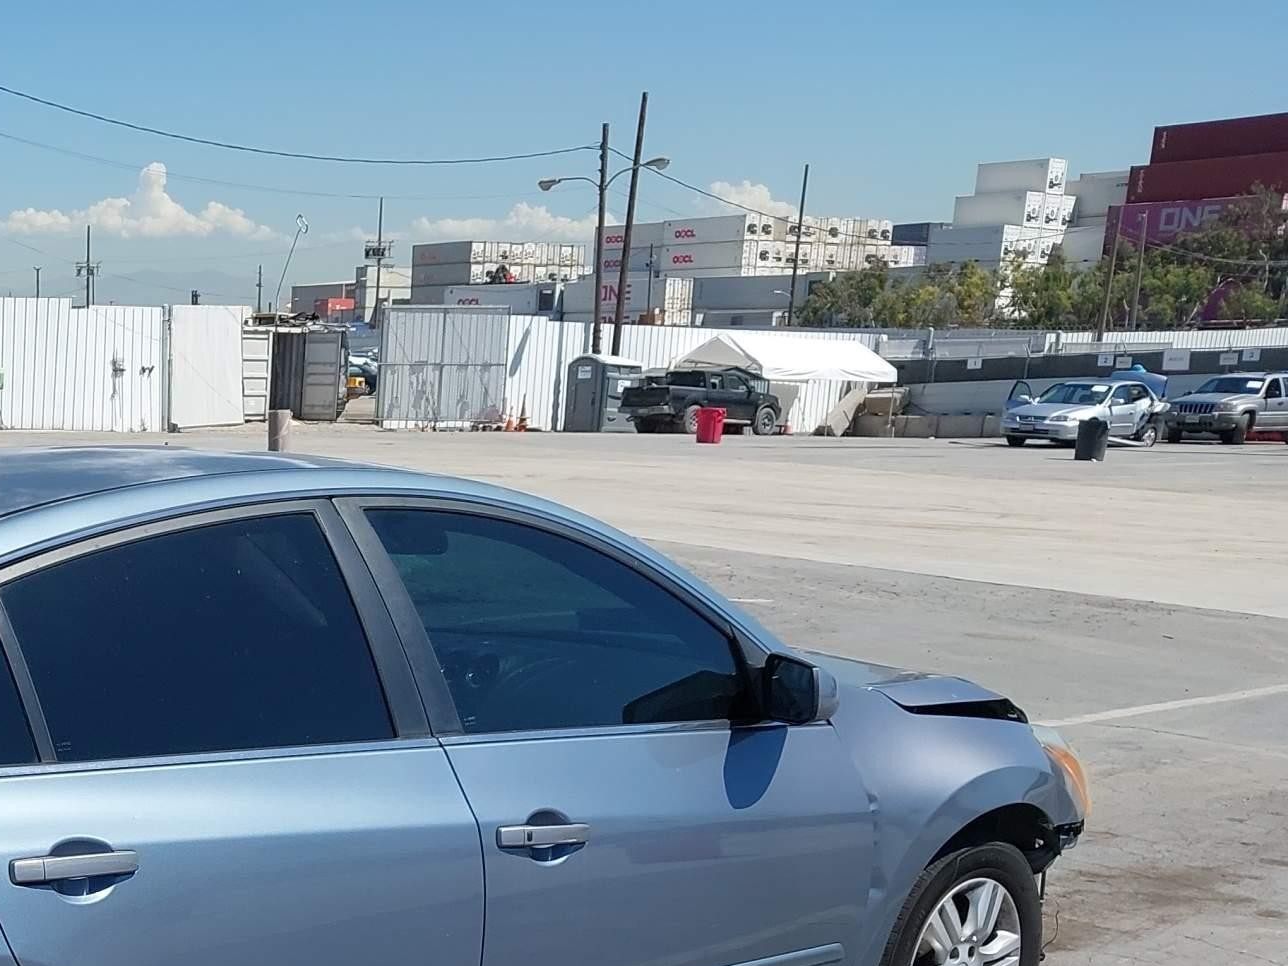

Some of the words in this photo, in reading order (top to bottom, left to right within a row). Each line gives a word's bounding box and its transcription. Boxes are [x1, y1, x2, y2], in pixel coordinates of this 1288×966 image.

[1159, 204, 1222, 233] ONE
[674, 229, 696, 239] OOCL
[672, 255, 694, 264] OOCL
